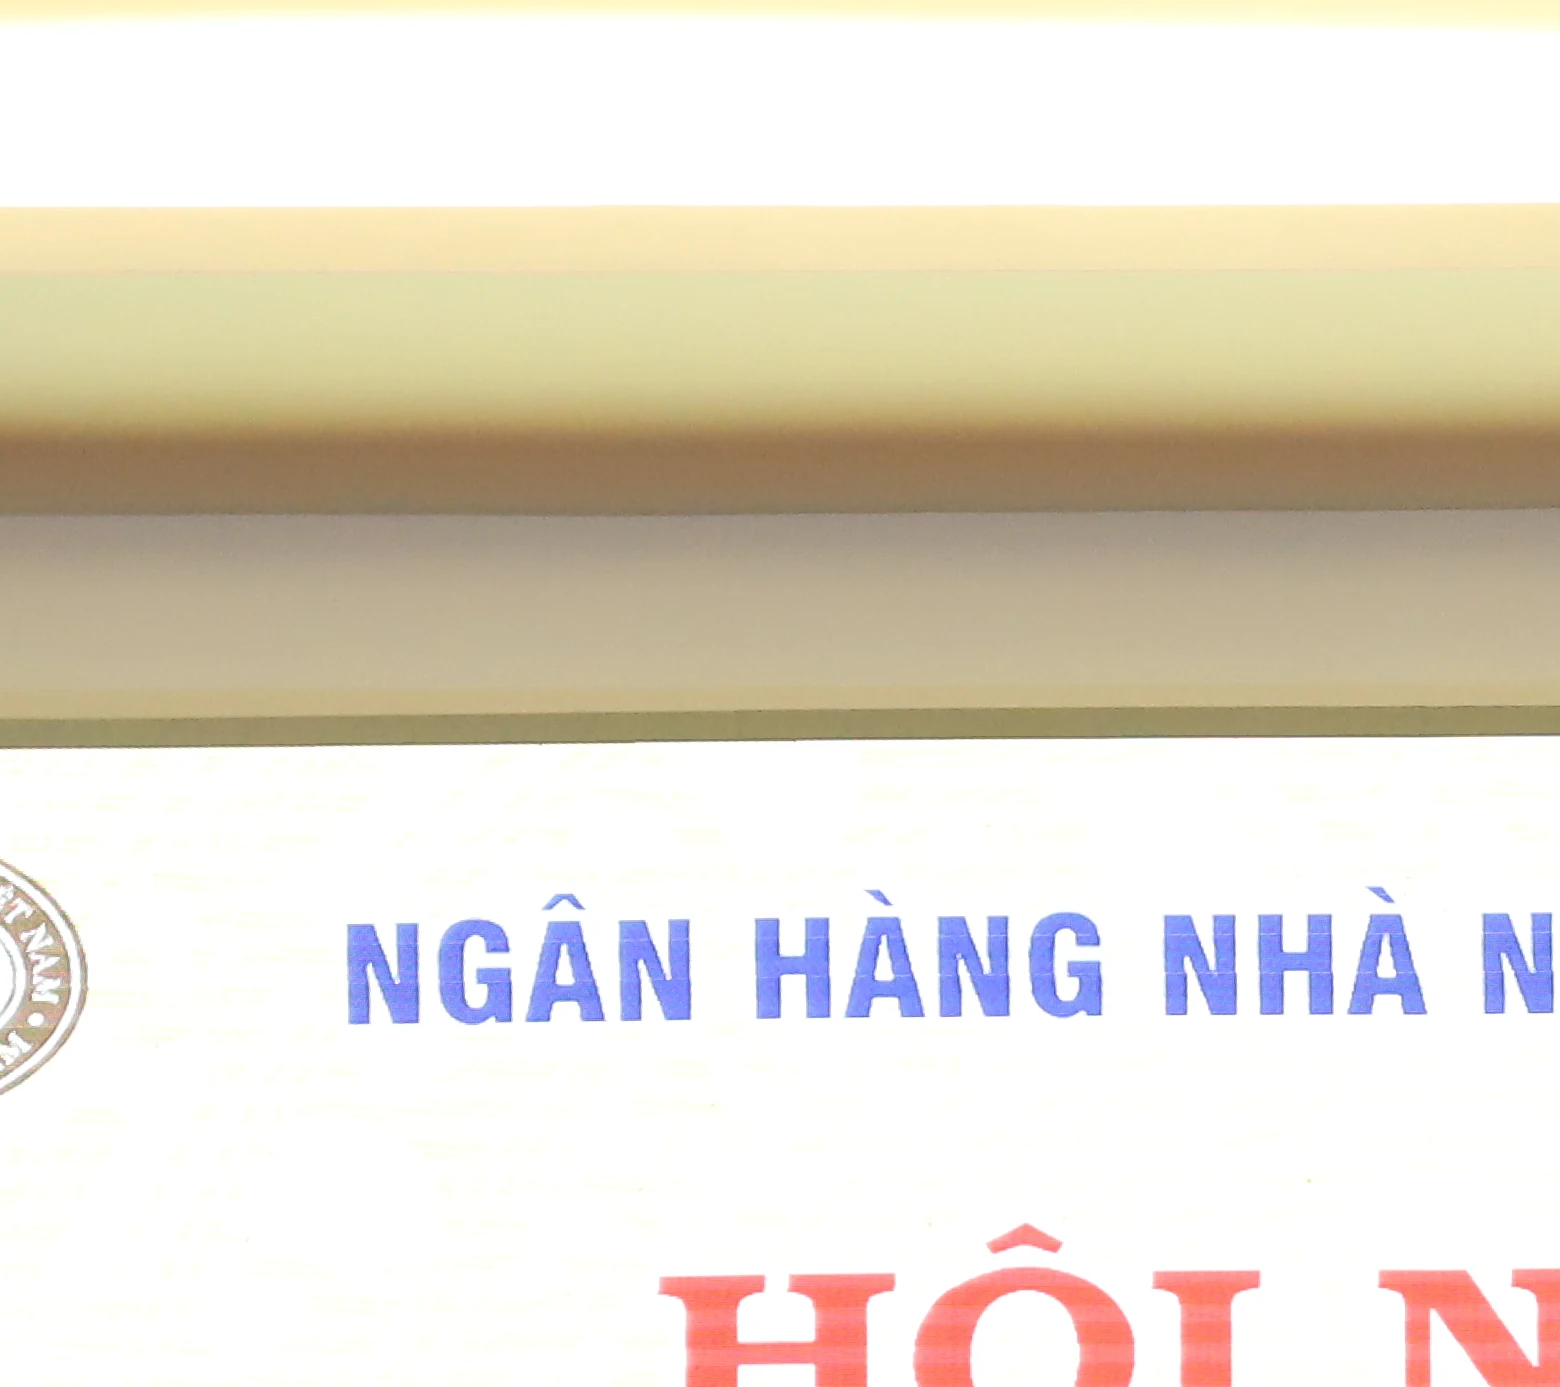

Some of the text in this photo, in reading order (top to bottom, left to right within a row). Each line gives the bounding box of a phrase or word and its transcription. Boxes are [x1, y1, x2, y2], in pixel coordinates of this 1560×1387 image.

[22, 920, 63, 1006] NAM
[348, 893, 691, 1025] NGÂN
[755, 888, 1103, 1019] HÀNG
[1164, 885, 1428, 1016] NHÀ
